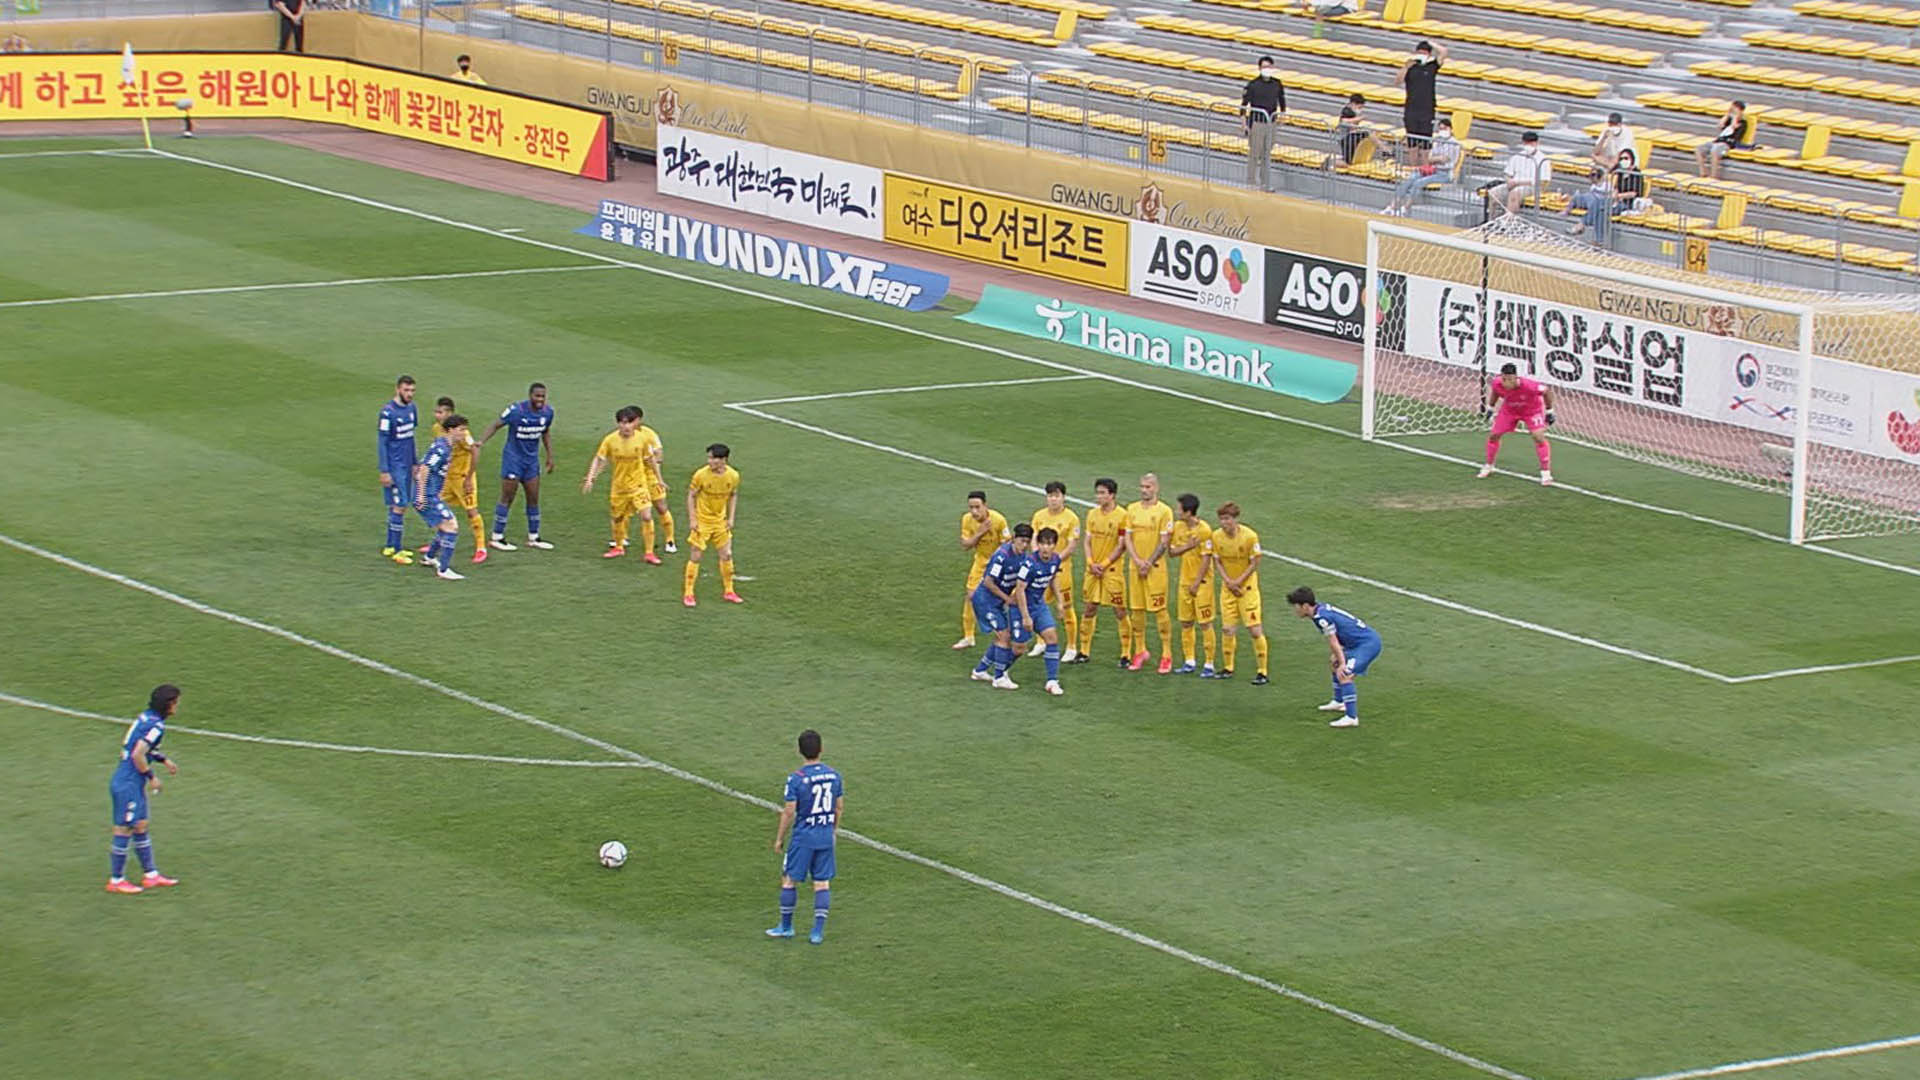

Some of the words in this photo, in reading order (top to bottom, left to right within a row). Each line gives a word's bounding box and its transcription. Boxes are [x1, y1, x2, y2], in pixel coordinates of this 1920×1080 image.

[34, 71, 106, 109] 하고
[198, 70, 300, 108] 해원아
[309, 75, 359, 117] 나와
[363, 82, 401, 125] 함께
[406, 91, 461, 138] 꽃길만
[467, 104, 504, 147] 걷자
[524, 124, 571, 162] 장진우
[587, 87, 651, 116] GWANGJU
[1151, 138, 1166, 157] C5
[715, 151, 797, 202] 대한민국
[800, 172, 877, 220] 미래로!
[600, 201, 656, 230] 프리미엄
[1050, 184, 1134, 216] GWANGJU
[1168, 200, 1201, 228] Our
[1201, 207, 1251, 240] Pride
[902, 203, 935, 237] 여수
[939, 196, 1107, 268] 디오션리조트
[655, 212, 821, 286] HYUNDAI
[822, 252, 923, 308] XTeer
[1147, 235, 1219, 286] ASO
[1686, 244, 1707, 267] C4
[1198, 291, 1239, 312] SPORT
[1280, 261, 1359, 317] ASO
[1599, 289, 1700, 327] GWANGJU
[1081, 311, 1172, 368] Hana
[1184, 335, 1274, 388] Bank
[1335, 320, 1381, 342] SPO
[1201, 608, 1212, 619] 10
[811, 782, 833, 814] 23
